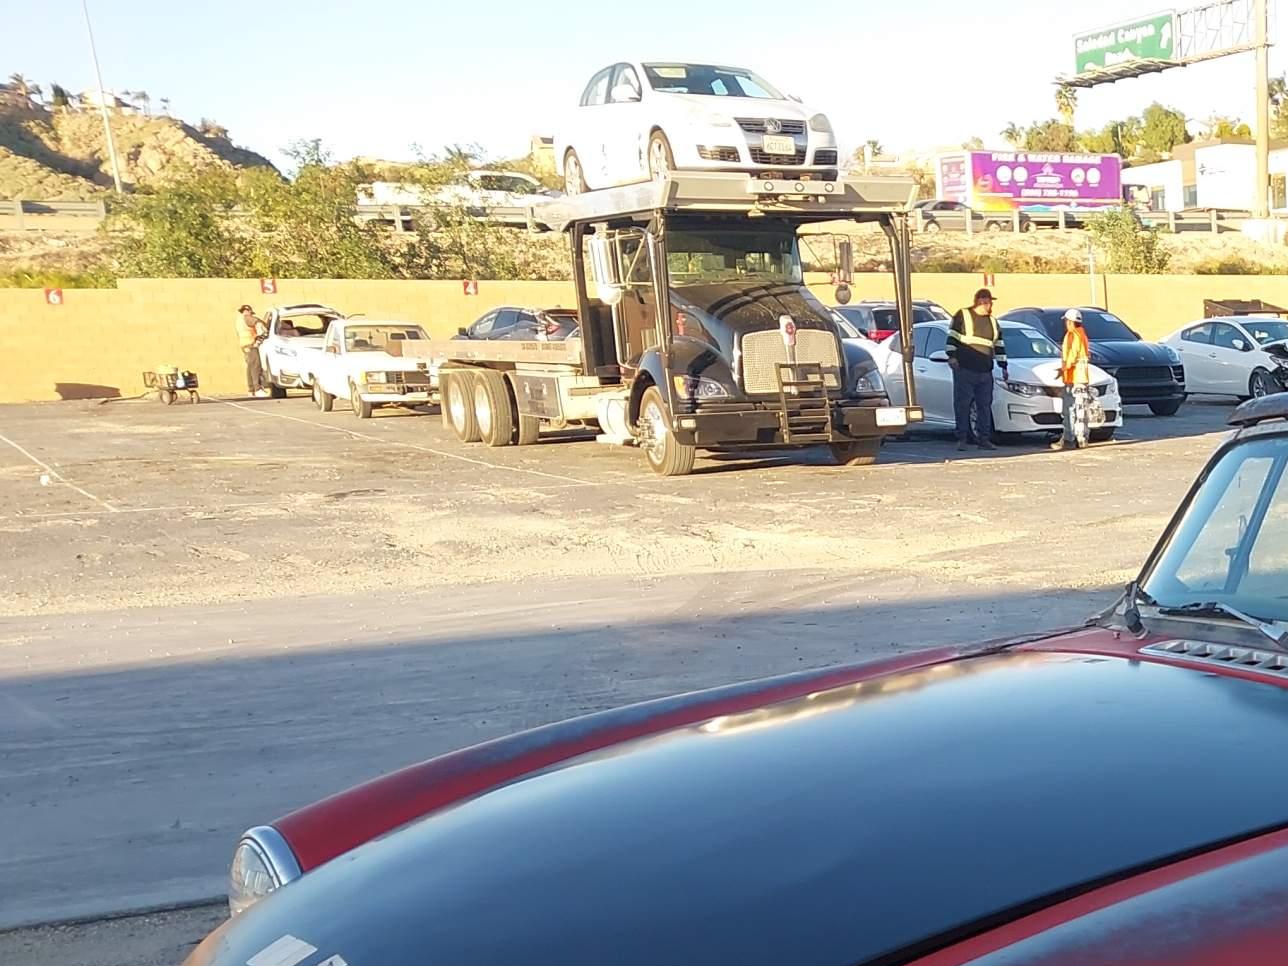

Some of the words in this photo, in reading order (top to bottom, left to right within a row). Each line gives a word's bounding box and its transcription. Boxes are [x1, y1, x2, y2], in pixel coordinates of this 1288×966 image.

[264, 279, 274, 294] 5
[466, 280, 475, 295] 4
[49, 290, 60, 304] 6
